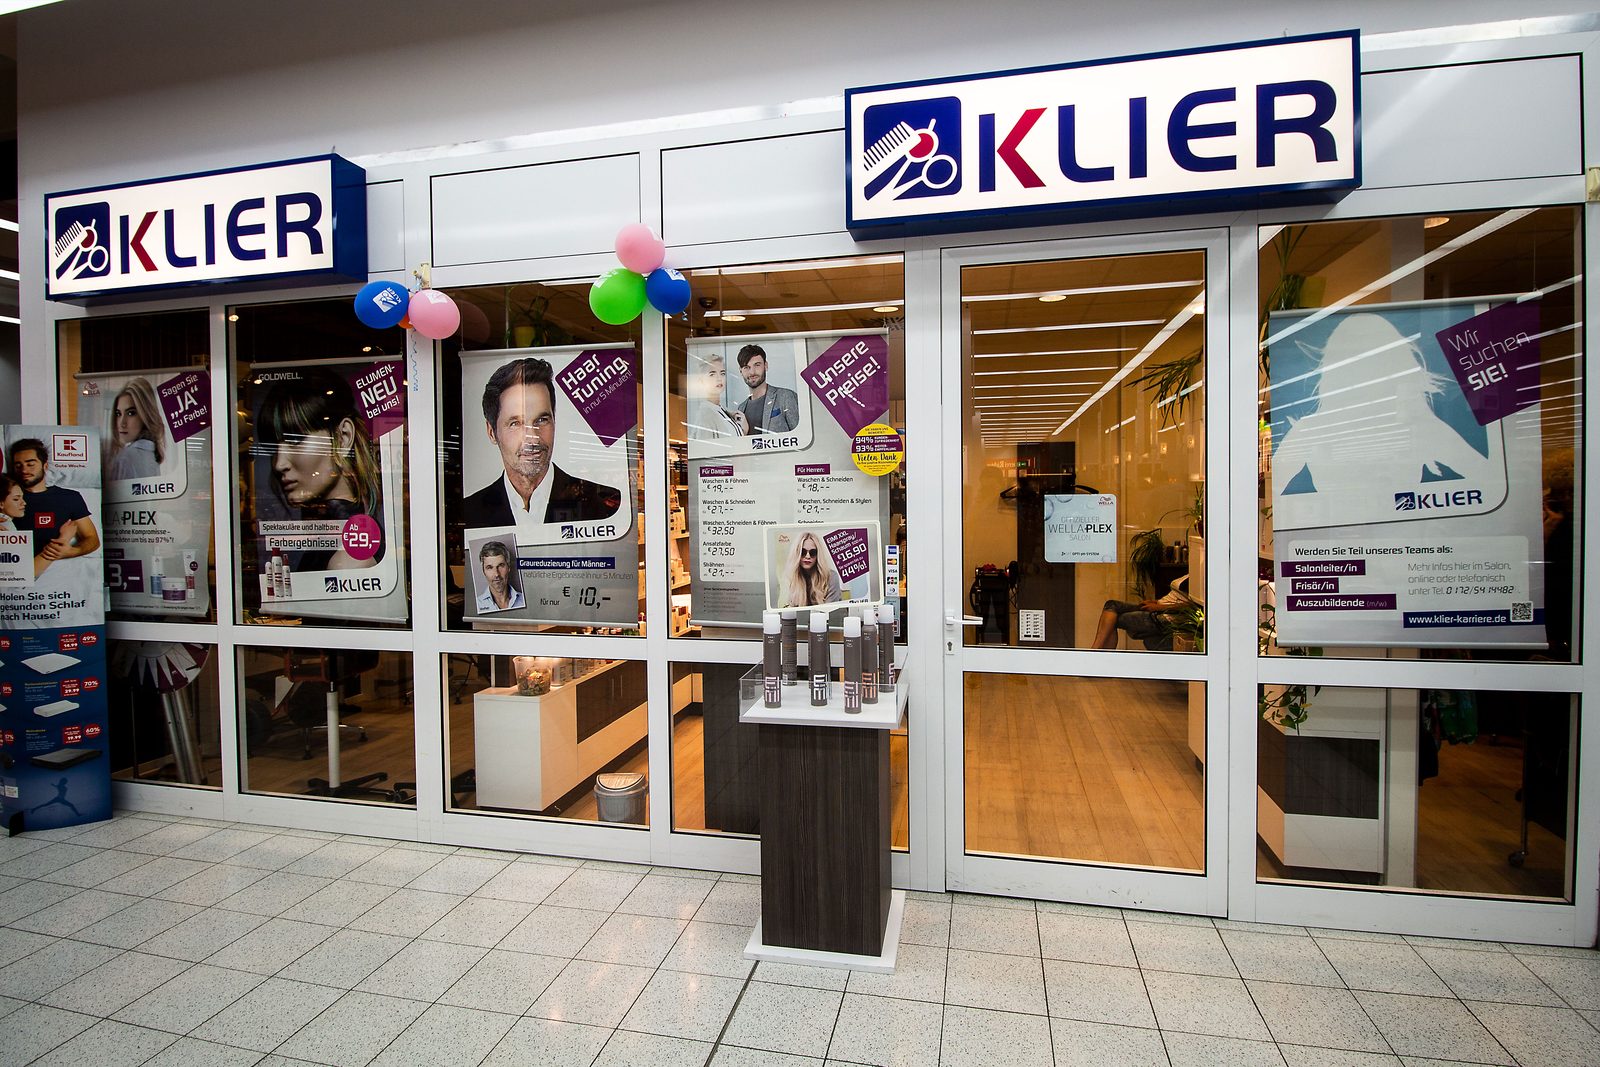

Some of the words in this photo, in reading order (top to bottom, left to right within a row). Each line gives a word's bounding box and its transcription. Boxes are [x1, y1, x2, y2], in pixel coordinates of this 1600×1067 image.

[978, 79, 1338, 193] KLIER
[119, 191, 324, 275] KLIER
[1448, 330, 1479, 352] Wir
[1459, 332, 1530, 370] suchen
[812, 341, 869, 388] Unsere
[356, 364, 395, 389] ELUMEN-
[562, 354, 600, 391] Haar
[571, 356, 628, 403] Tuning
[1468, 362, 1508, 391] SIE!
[161, 380, 186, 398] Sagen
[185, 374, 198, 384] Sie
[825, 356, 880, 406] Preise!
[360, 376, 398, 408] NEU
[583, 406, 592, 414] in
[590, 397, 601, 409] nur
[599, 392, 606, 400] 5
[605, 370, 633, 396] Minuten!
[366, 404, 381, 419] bei
[381, 395, 400, 411] uns!
[172, 418, 183, 428] zu
[184, 406, 208, 424] Farbe!
[764, 437, 798, 448] KLIER
[141, 482, 174, 495] KLIER
[1417, 490, 1482, 509] KLIER
[262, 523, 300, 532] Spektakuläre
[302, 522, 313, 531] und
[314, 522, 340, 530] haltbare
[575, 525, 616, 538] KLIER
[269, 538, 338, 549] Farbergebnisse!
[1332, 547, 1346, 555] Sie
[1437, 546, 1453, 554] als:
[520, 560, 570, 568] Graureduzierung
[842, 560, 867, 577] 44%!
[1296, 564, 1357, 572] Salonleiter/in
[1408, 563, 1430, 571] Mehr
[1432, 562, 1453, 571] Infos
[1454, 562, 1471, 570] hier
[1472, 562, 1482, 570] im
[339, 578, 382, 592] KLIER
[1436, 575, 1456, 583] oder
[1458, 574, 1505, 582] telefonisch
[562, 586, 570, 597] €
[1296, 582, 1335, 590] Frisör/in
[28, 592, 44, 600] Sie
[1296, 599, 1365, 607] Auszubildende
[0, 603, 46, 613] gesunden
[49, 600, 86, 609] Schlaf
[22, 611, 60, 620] Hause!
[1408, 615, 1506, 624] www.klier-karriere.de
